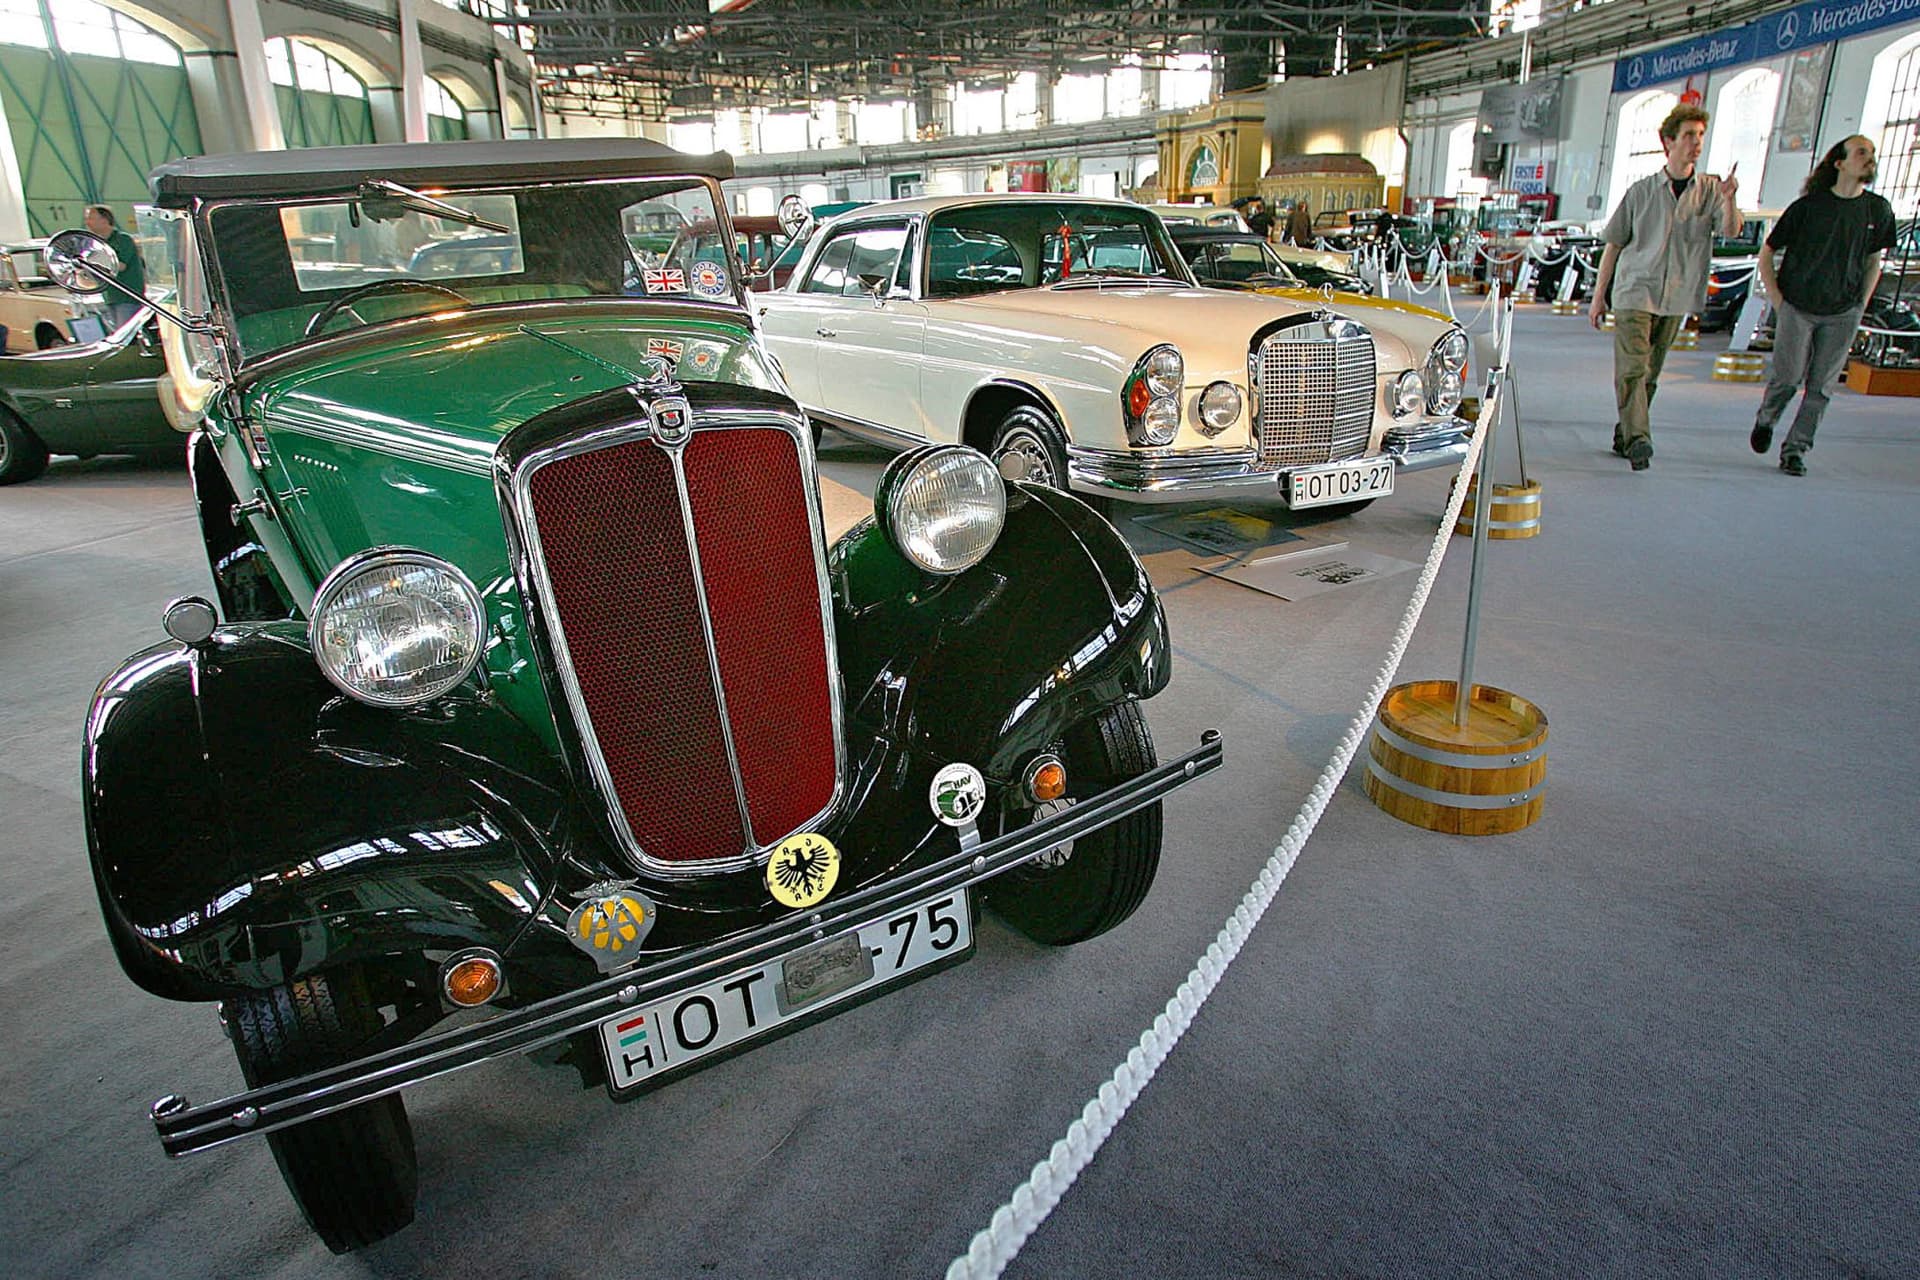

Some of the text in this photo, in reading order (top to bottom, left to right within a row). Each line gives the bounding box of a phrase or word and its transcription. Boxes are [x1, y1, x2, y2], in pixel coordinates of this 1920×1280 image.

[1651, 40, 1738, 78] Mercedes-Benz
[1296, 491, 1303, 501] H
[622, 1045, 654, 1077] H
